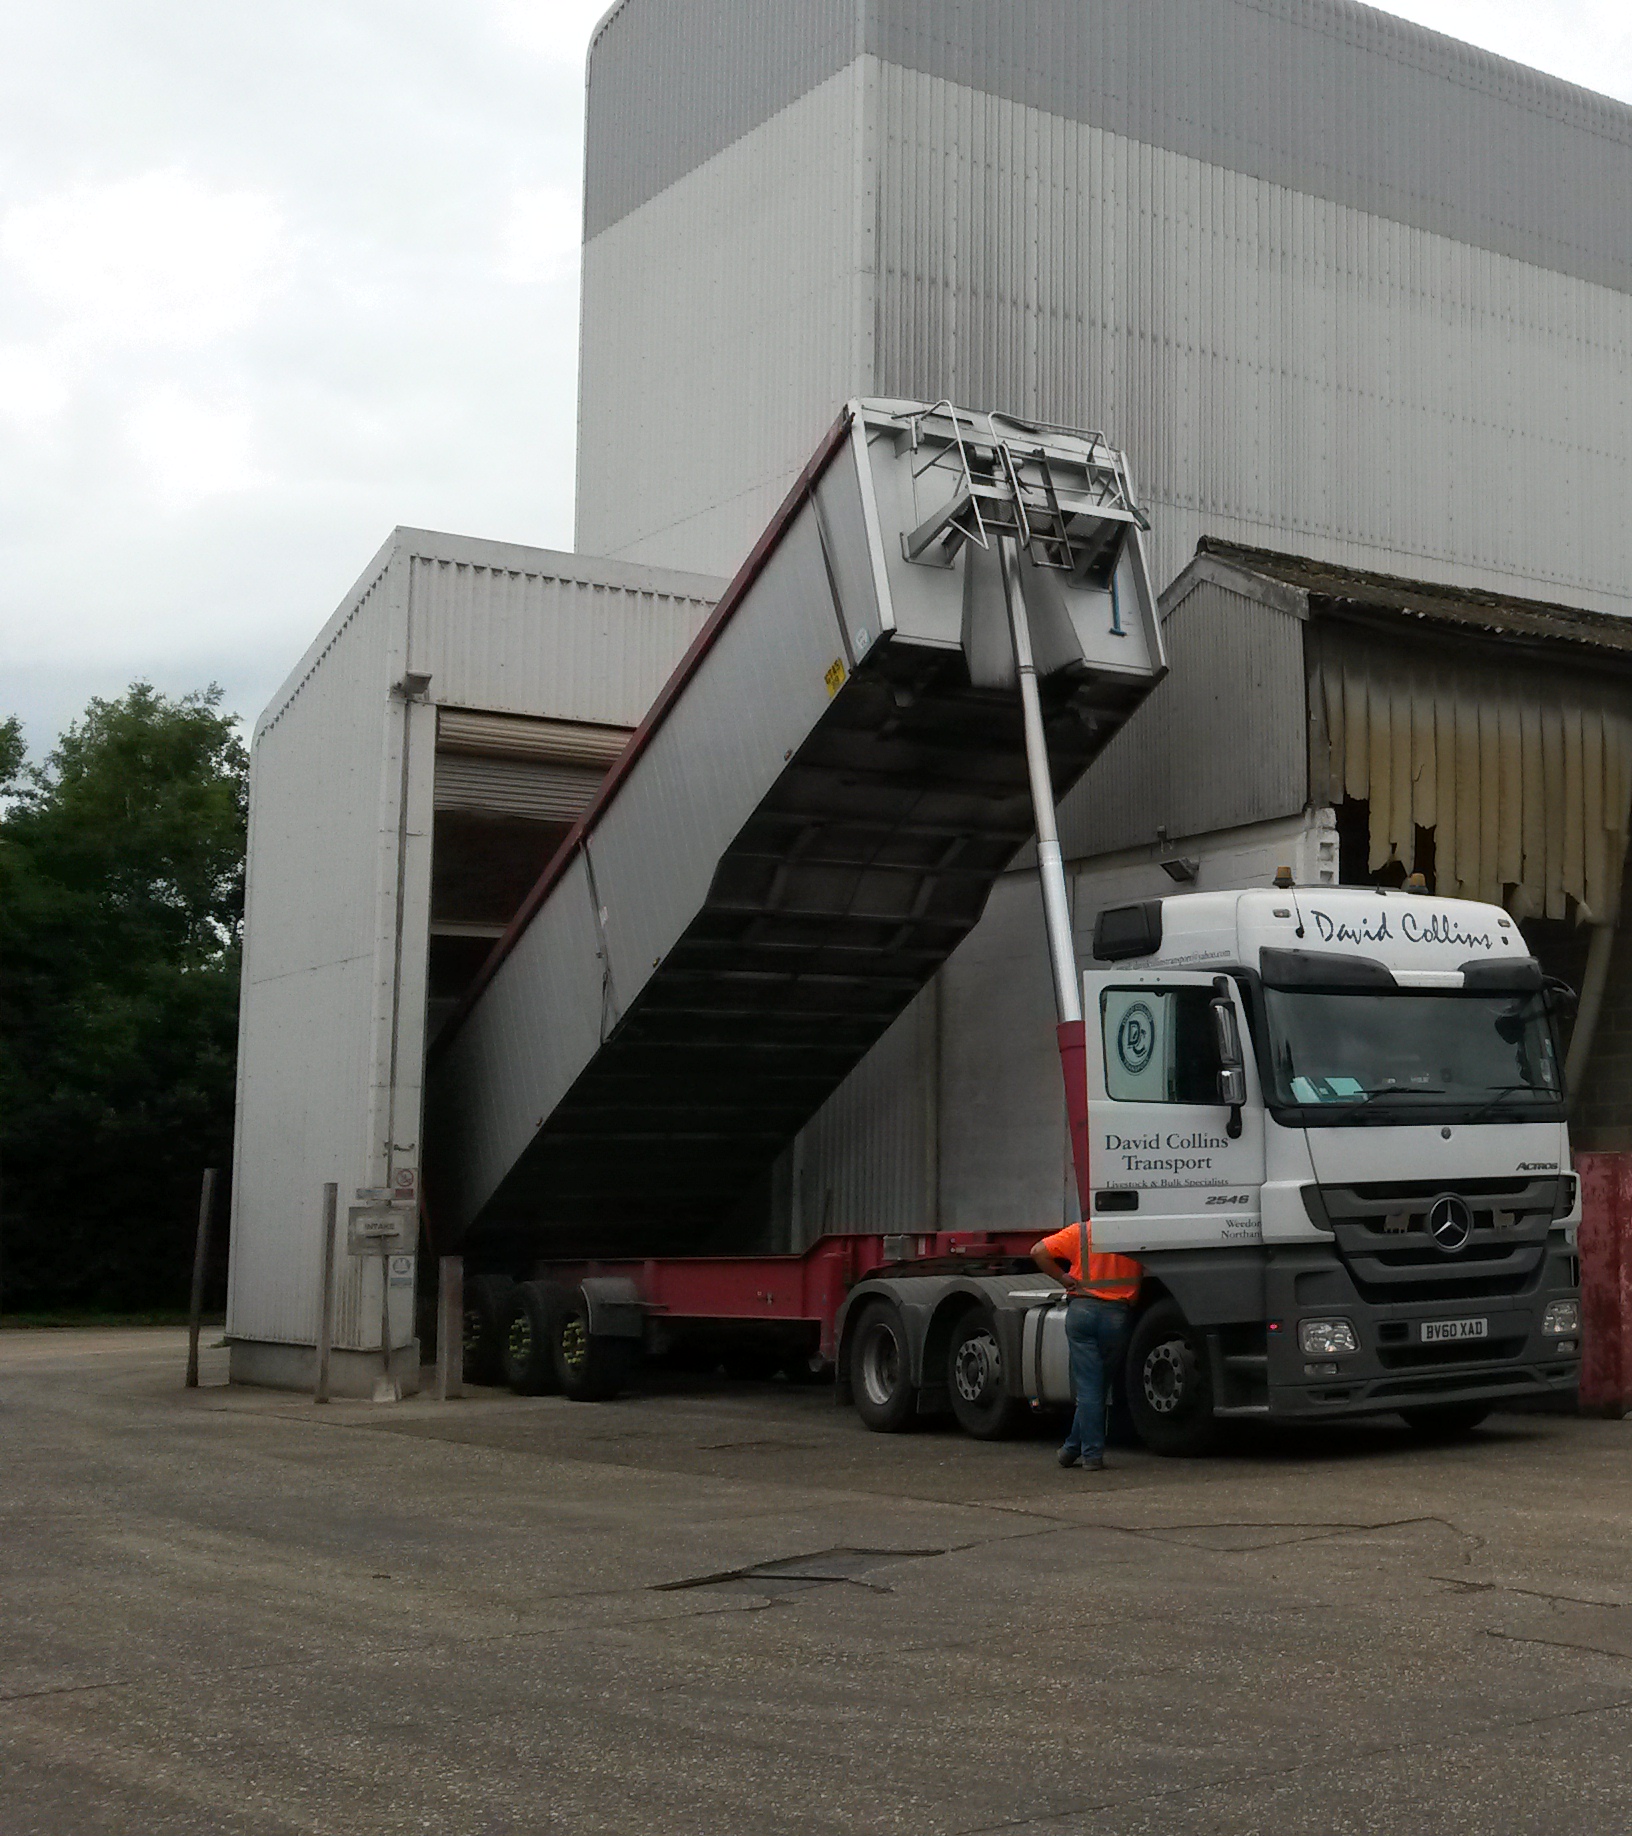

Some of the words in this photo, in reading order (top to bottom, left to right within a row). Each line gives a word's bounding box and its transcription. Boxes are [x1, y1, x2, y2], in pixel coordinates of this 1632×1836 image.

[1310, 909, 1394, 945] David
[1401, 912, 1493, 950] Collins
[1105, 1133, 1160, 1150] David
[1166, 1133, 1229, 1149] Collins
[1121, 1154, 1212, 1174] Transport
[1106, 1180, 1147, 1189] Livestock
[1160, 1179, 1182, 1188] Bulk
[1184, 1178, 1229, 1187] Specialists
[1205, 1195, 1249, 1205] 2546
[1426, 1324, 1457, 1339] BV60
[1460, 1321, 1483, 1336] XAD
